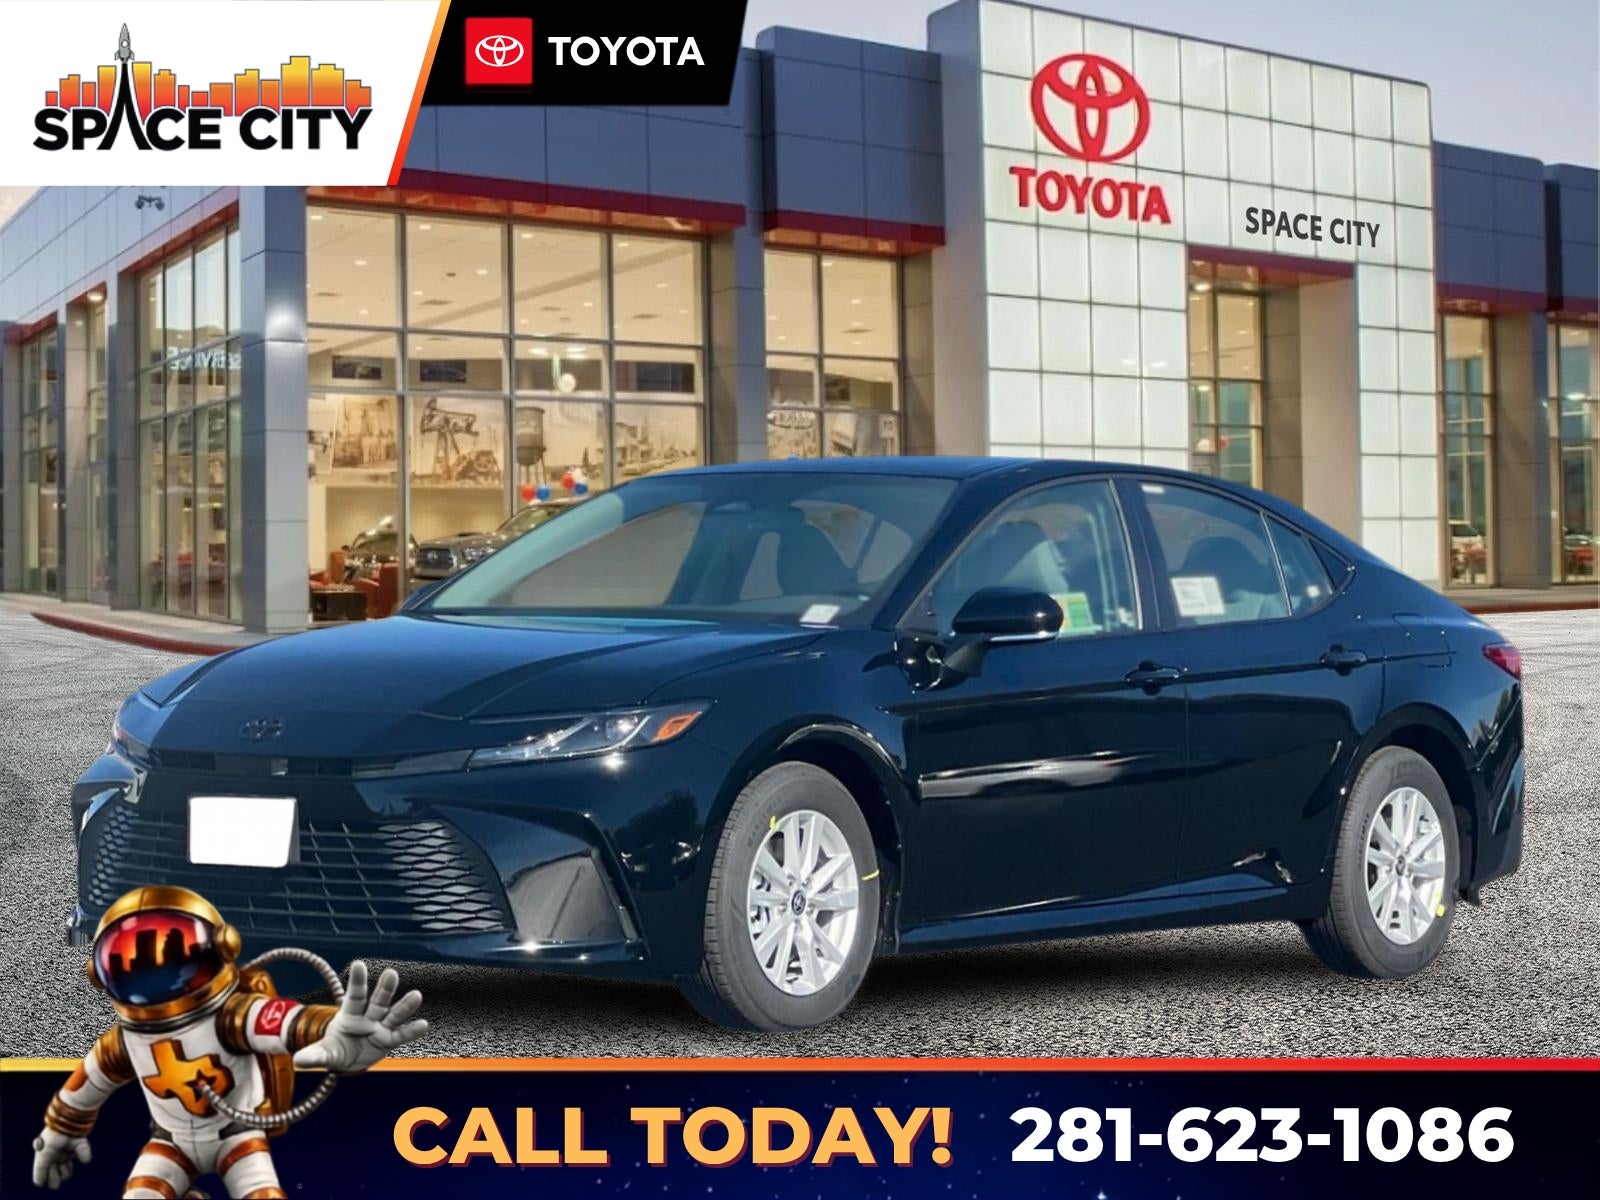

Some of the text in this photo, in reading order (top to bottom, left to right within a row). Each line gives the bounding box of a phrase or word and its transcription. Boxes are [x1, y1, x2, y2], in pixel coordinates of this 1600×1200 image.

[1009, 165, 1172, 224] TOYOTA
[1245, 206, 1380, 248] SPACE CITY
